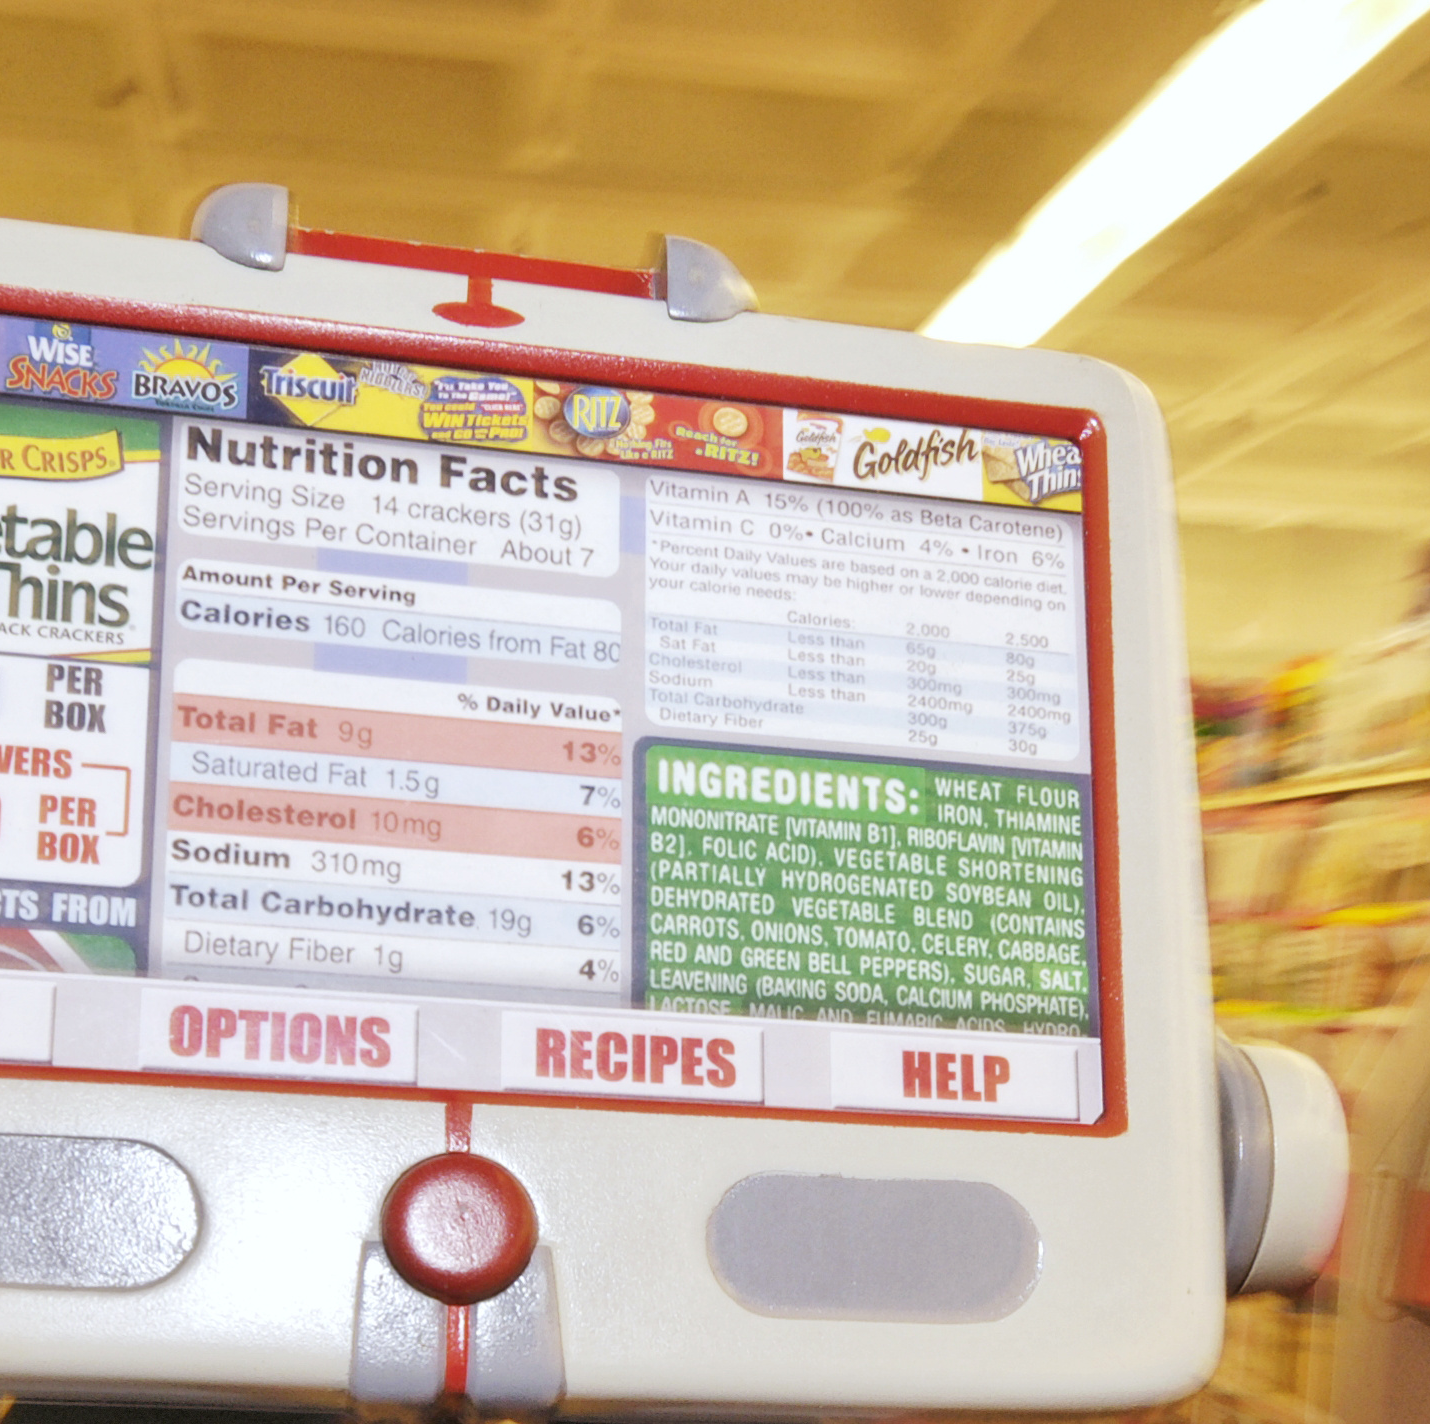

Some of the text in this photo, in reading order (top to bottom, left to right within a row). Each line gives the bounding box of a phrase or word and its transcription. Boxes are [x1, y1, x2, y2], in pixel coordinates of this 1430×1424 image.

[27, 335, 93, 366] WISE
[6, 356, 118, 399] SNACKS
[132, 371, 238, 410] BRAVOS
[262, 366, 359, 405] Triscuit
[573, 394, 621, 431] RITZ
[23, 444, 109, 475] CRISPS
[185, 425, 579, 502] Nutrition Facts
[852, 427, 979, 481] Goldfish
[184, 473, 582, 542] Serving Size 14 crackers (31g)
[649, 479, 1063, 542] Vitamin A 15% (100% as Beta Carotene)
[182, 505, 595, 568] Servings Per Container About 7
[182, 565, 417, 607] Amount Per Serving
[36, 624, 126, 646] CRACKERS
[180, 599, 310, 633] Calories
[323, 614, 366, 640] 160
[382, 618, 481, 651] Calories
[488, 628, 542, 657] from
[550, 635, 587, 661] Fat
[46, 663, 103, 697] PER
[43, 700, 107, 734] BOX
[458, 692, 479, 712] %
[486, 696, 540, 720] Daily
[177, 704, 255, 735] Total
[268, 713, 318, 741] Fat
[561, 739, 622, 768] 13%
[192, 750, 318, 785] Saturated
[328, 761, 367, 789] Fat
[579, 783, 622, 811] 7%
[658, 758, 1080, 816] INGREDIENTS: WHEAT FLOUR
[38, 794, 97, 828] PER
[172, 794, 357, 832] Cholesterol
[576, 825, 621, 852] 6%
[995, 808, 1082, 836] THIAMINE
[36, 831, 101, 865] BOX
[171, 837, 291, 870] Sodium
[560, 869, 621, 897] 13%
[51, 893, 136, 928] FROM
[170, 883, 249, 912] Total
[261, 889, 477, 930] Carbohydrate
[576, 912, 621, 941] 6%
[183, 928, 278, 966] Dietary
[288, 938, 356, 966] Fiber
[579, 958, 620, 984] 4%
[650, 940, 687, 964] RED
[693, 944, 733, 967] AND
[740, 946, 801, 972] GREEN
[808, 951, 851, 976] BELL
[168, 1004, 392, 1069] OPTIONS
[535, 1026, 737, 1089] RECIPES
[901, 1049, 1012, 1102] HELP
